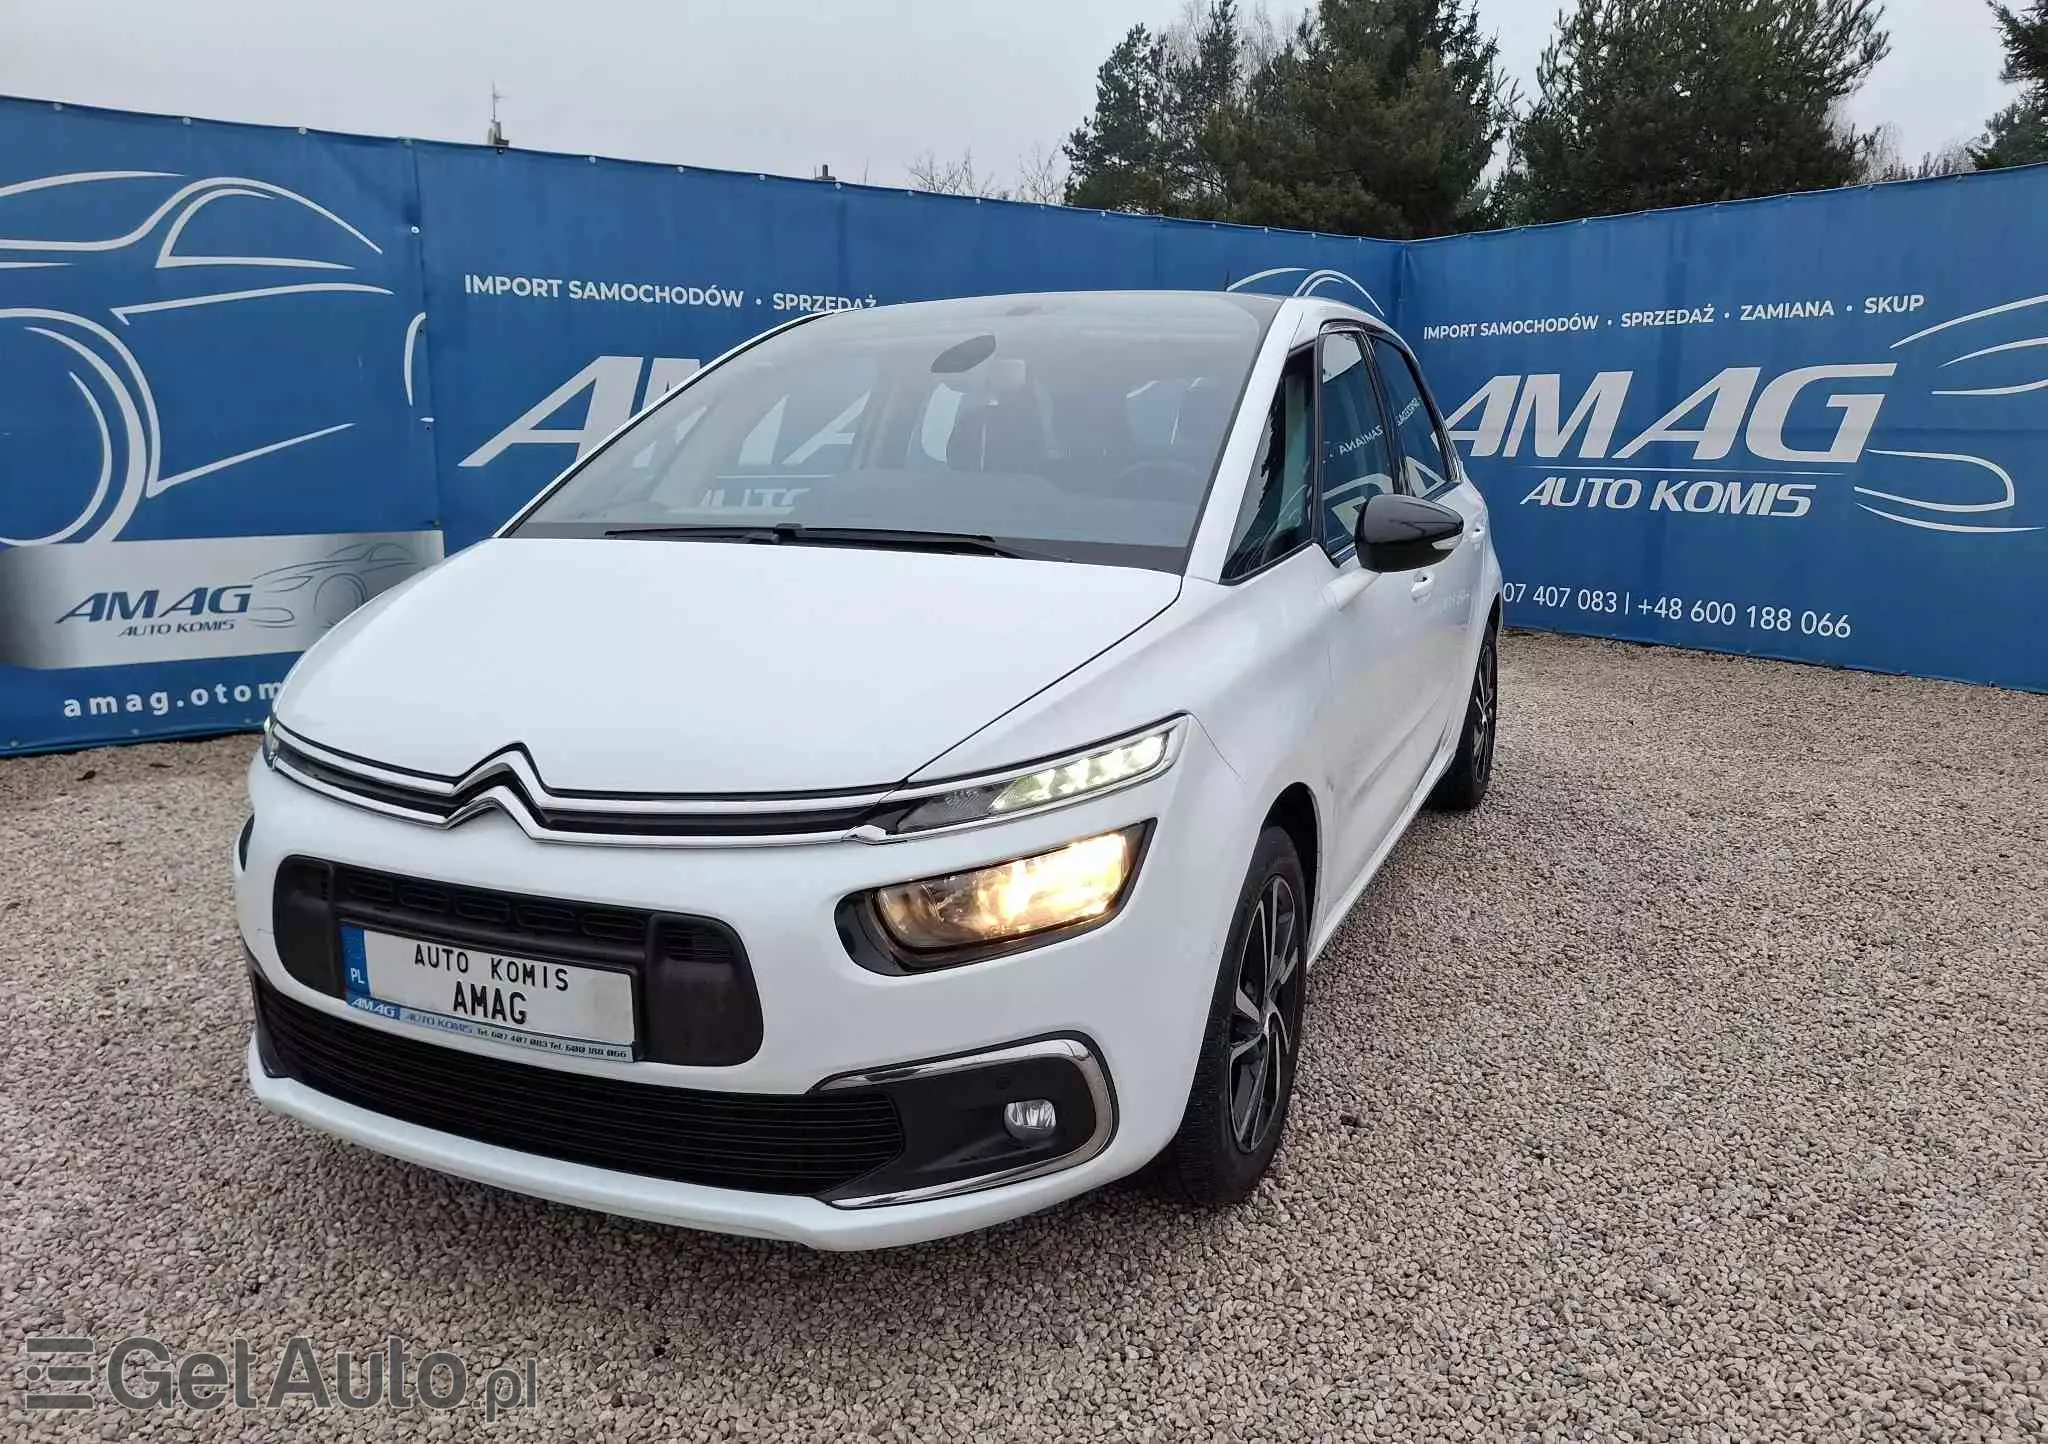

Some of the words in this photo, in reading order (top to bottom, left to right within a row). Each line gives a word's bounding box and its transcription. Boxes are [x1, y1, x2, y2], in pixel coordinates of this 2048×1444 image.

[464, 274, 562, 298] IMPORT
[568, 279, 744, 308] SAMOCHODÓW
[1423, 323, 1477, 340] IMPORT
[1480, 312, 1600, 337] SAMOCHODÓW
[1620, 303, 1715, 328] SPRZEDAŻ
[1739, 300, 1835, 321] ZAMIANA
[1863, 294, 1925, 314] SKUP
[1445, 362, 1898, 463] AMAG
[1519, 476, 1642, 510] AUTO
[1649, 479, 1817, 517] KOMIS
[54, 583, 253, 624] AMAG
[1533, 585, 1572, 608] 407
[1577, 588, 1618, 613] 083
[1637, 595, 1682, 620] +48
[1690, 599, 1737, 626] 600
[1746, 604, 1792, 631] 188
[1800, 610, 1852, 638] 066
[117, 623, 171, 638] AUTO
[175, 618, 237, 633] KOMIS
[350, 967, 365, 984] PL
[414, 943, 469, 974] AUTO
[490, 957, 570, 992] KOMIS
[351, 998, 396, 1017] AMAG
[453, 980, 527, 1025] AMAG
